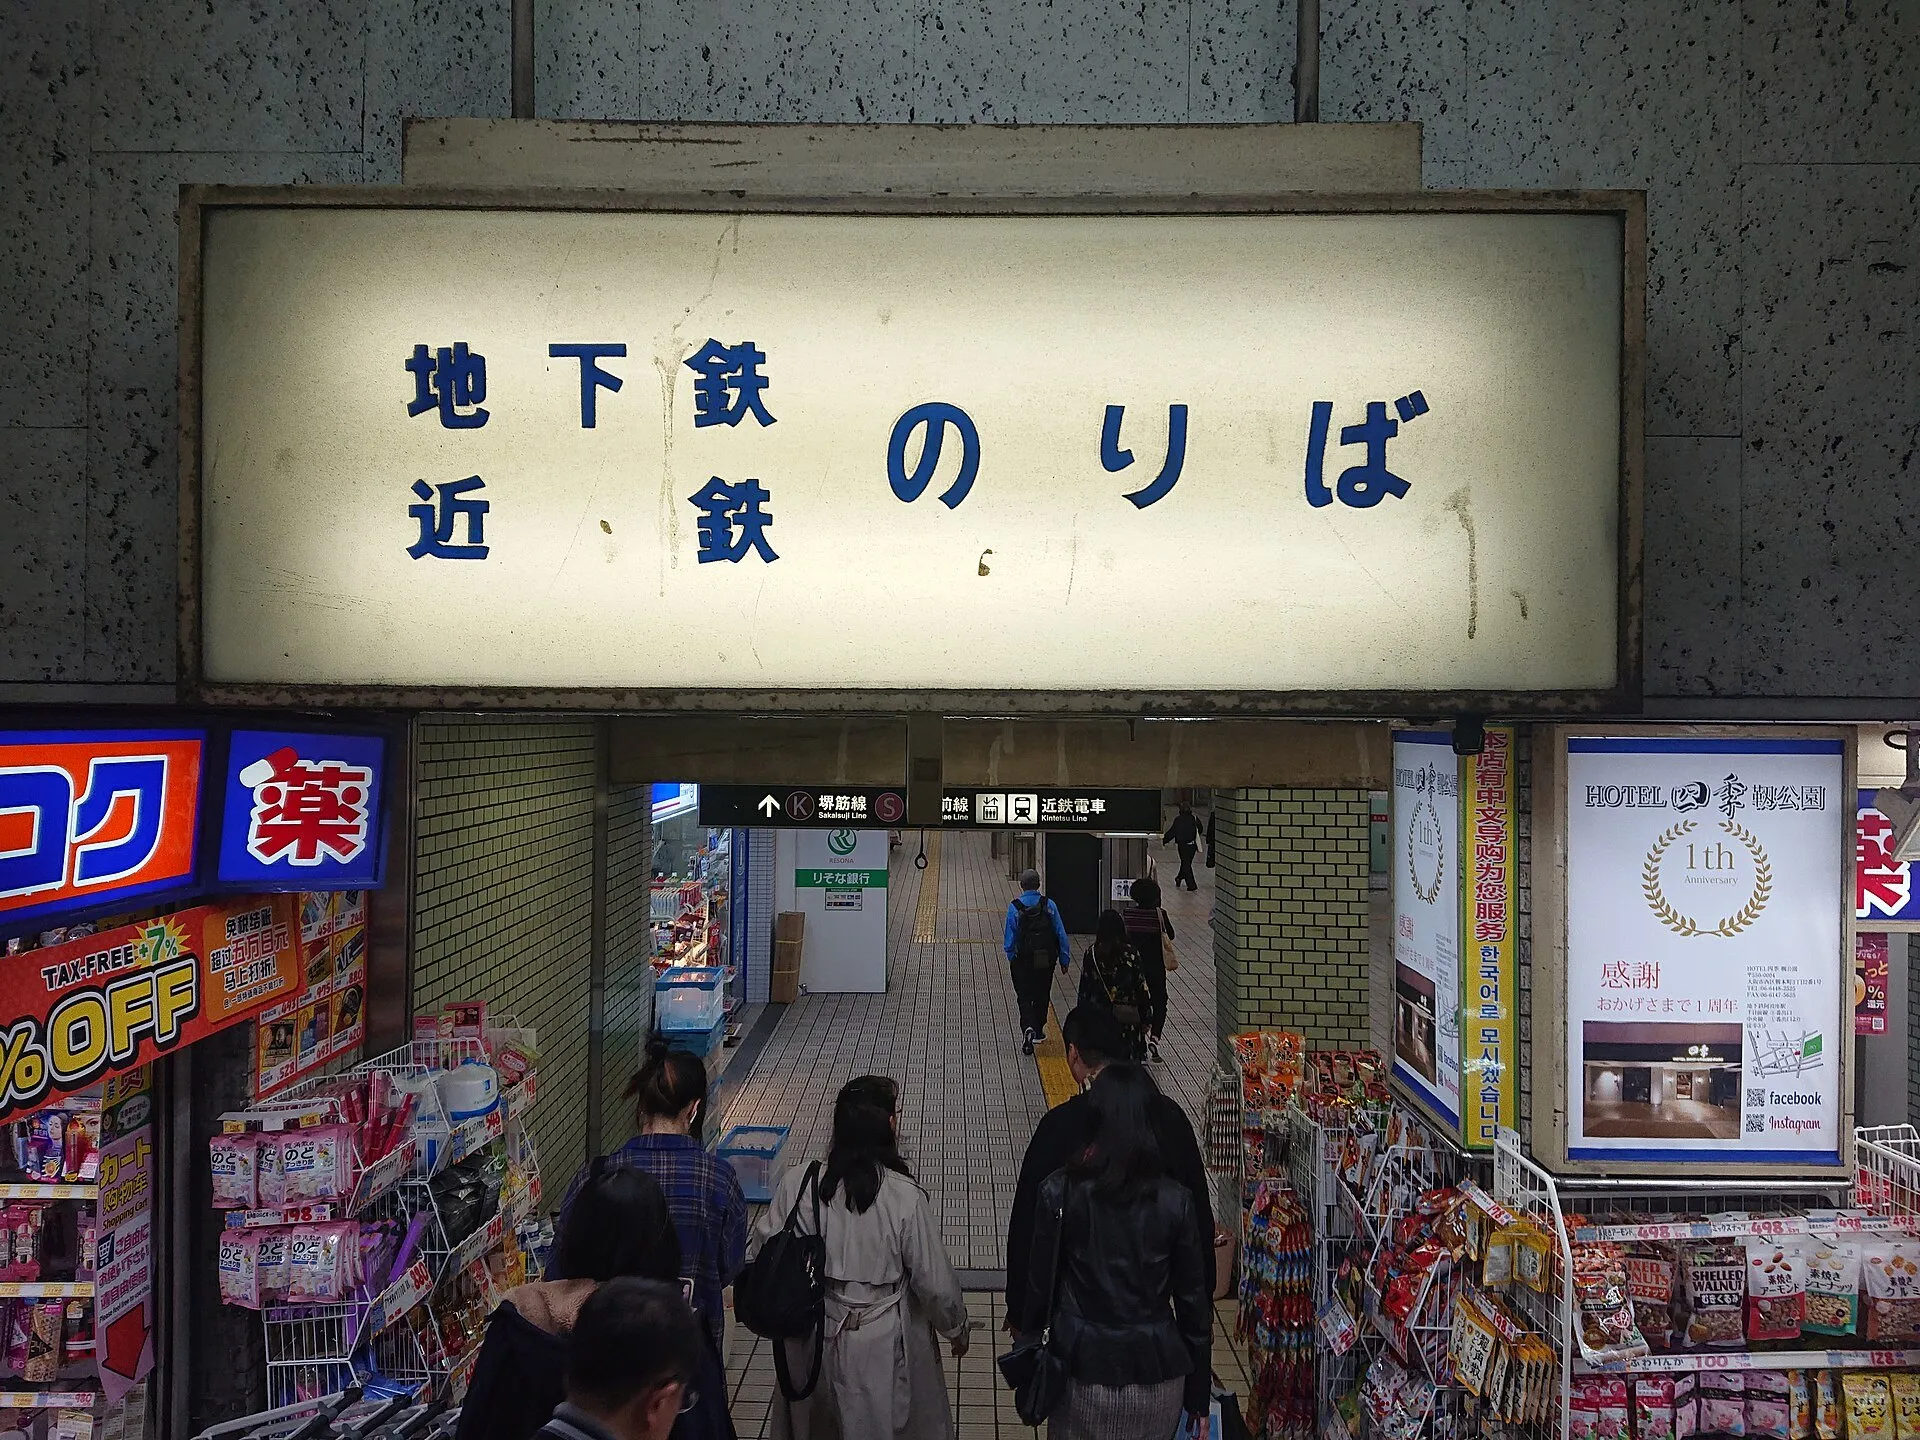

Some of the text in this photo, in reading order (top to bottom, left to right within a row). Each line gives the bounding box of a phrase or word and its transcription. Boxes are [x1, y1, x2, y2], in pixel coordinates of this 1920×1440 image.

[405, 338, 777, 430] 地下鉄
[887, 390, 1430, 511] のりば
[405, 474, 780, 565] 近鉄
[818, 795, 867, 811] 堺筋線
[942, 796, 969, 813] 前線
[1585, 784, 1667, 808] HOTEL
[1670, 773, 1748, 820] 四季
[241, 748, 372, 864] 薬
[1041, 798, 1106, 814] 近鉄電車
[818, 811, 850, 820] Sakaisuji
[1685, 842, 1735, 871] 1th
[813, 872, 870, 885] りそな銀行
[1684, 874, 1739, 886] Anniversary
[42, 945, 135, 991] TAX-FREE
[1600, 960, 1661, 990] 感謝
[1479, 945, 1501, 1020] 한국어로
[1597, 996, 1739, 1014] おかげさまで1周年
[1479, 1028, 1501, 1141] 모시겠습니다
[1769, 1091, 1822, 1105] facebook
[1768, 1115, 1821, 1135] Instagram
[211, 1152, 237, 1165] のど
[284, 1147, 315, 1161] のど
[99, 1136, 152, 1192] カート
[103, 1171, 148, 1216] 购物车
[103, 1198, 148, 1231] Shopping Cart
[283, 1207, 313, 1223] 198
[1893, 1215, 1915, 1226] 498
[1750, 1221, 1784, 1234] 498
[1838, 1218, 1862, 1228] 498
[1637, 1226, 1671, 1239] 498
[220, 1248, 243, 1261] のど
[1692, 1270, 1744, 1281] SHELLED
[1767, 1274, 1793, 1285] 素焼き
[1810, 1269, 1841, 1282] 素焼き
[1760, 1283, 1800, 1295] アーモンド
[1695, 1355, 1728, 1368] 100
[1870, 1351, 1895, 1365] 128
[1853, 1406, 1887, 1418] レモン
